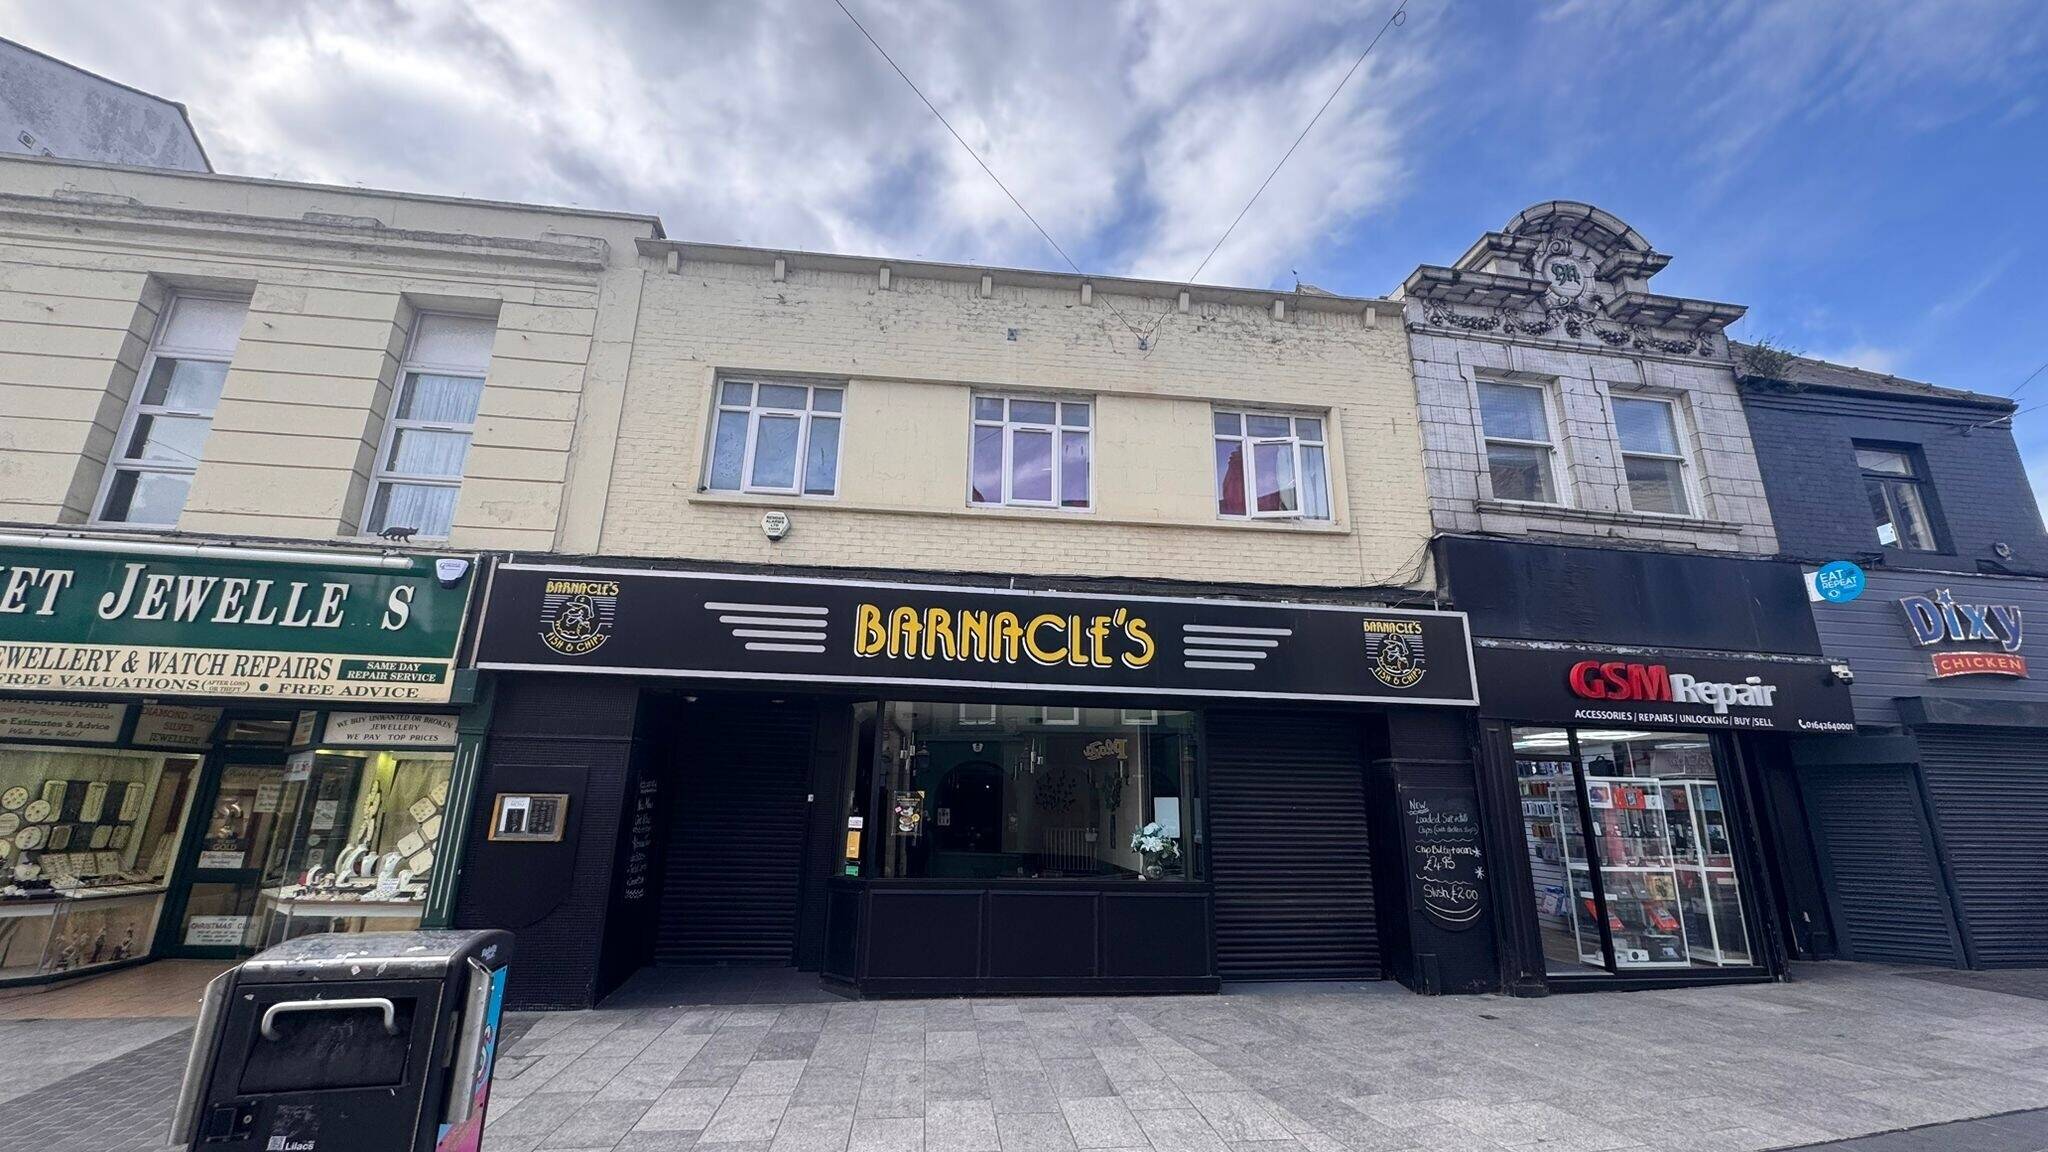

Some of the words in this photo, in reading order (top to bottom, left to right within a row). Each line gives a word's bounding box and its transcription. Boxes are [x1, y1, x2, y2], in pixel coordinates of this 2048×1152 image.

[1819, 569, 1843, 583] EAT
[1822, 576, 1857, 589] REPEAT
[0, 566, 74, 615] ET
[545, 581, 619, 596] BARNACLE'S
[1363, 621, 1422, 634] BARNACLE'S
[545, 632, 564, 649] FISH
[576, 634, 604, 651] CHIPS
[853, 603, 1155, 670] BARNACLE'S
[122, 650, 140, 674] &
[148, 651, 230, 676] WATCH
[231, 655, 334, 681] REPAIRS
[366, 661, 397, 671] SAME
[398, 662, 422, 672] DAY
[1940, 656, 2022, 670] CHICKEN
[60, 675, 200, 691] VALUATIONS
[347, 670, 385, 680] REPAIR
[386, 672, 436, 682] SERVICE
[1374, 668, 1390, 682] FISH
[1401, 668, 1422, 684] CHIPS
[278, 683, 334, 696] FREE
[338, 685, 420, 698] ADVICE
[10, 718, 62, 728] Estimates
[76, 721, 110, 730] Advice
[336, 720, 348, 728] WE
[350, 716, 368, 725] BUY
[368, 714, 410, 722] UNWANTED
[411, 714, 422, 722] OR
[424, 716, 453, 729] BROKEN
[1574, 710, 1633, 721] ACCESSORIES
[1638, 712, 1674, 723] REPAIRS
[1679, 714, 1728, 726] UNLOCKING
[1734, 716, 1750, 726] BUY
[1754, 716, 1774, 727] SELL
[1806, 720, 1854, 730] 01642640001
[370, 723, 420, 732] JEWELLERY
[150, 732, 200, 744] JEWELLERY
[409, 734, 438, 742] PRICES
[1416, 812, 1440, 824] Loaded
